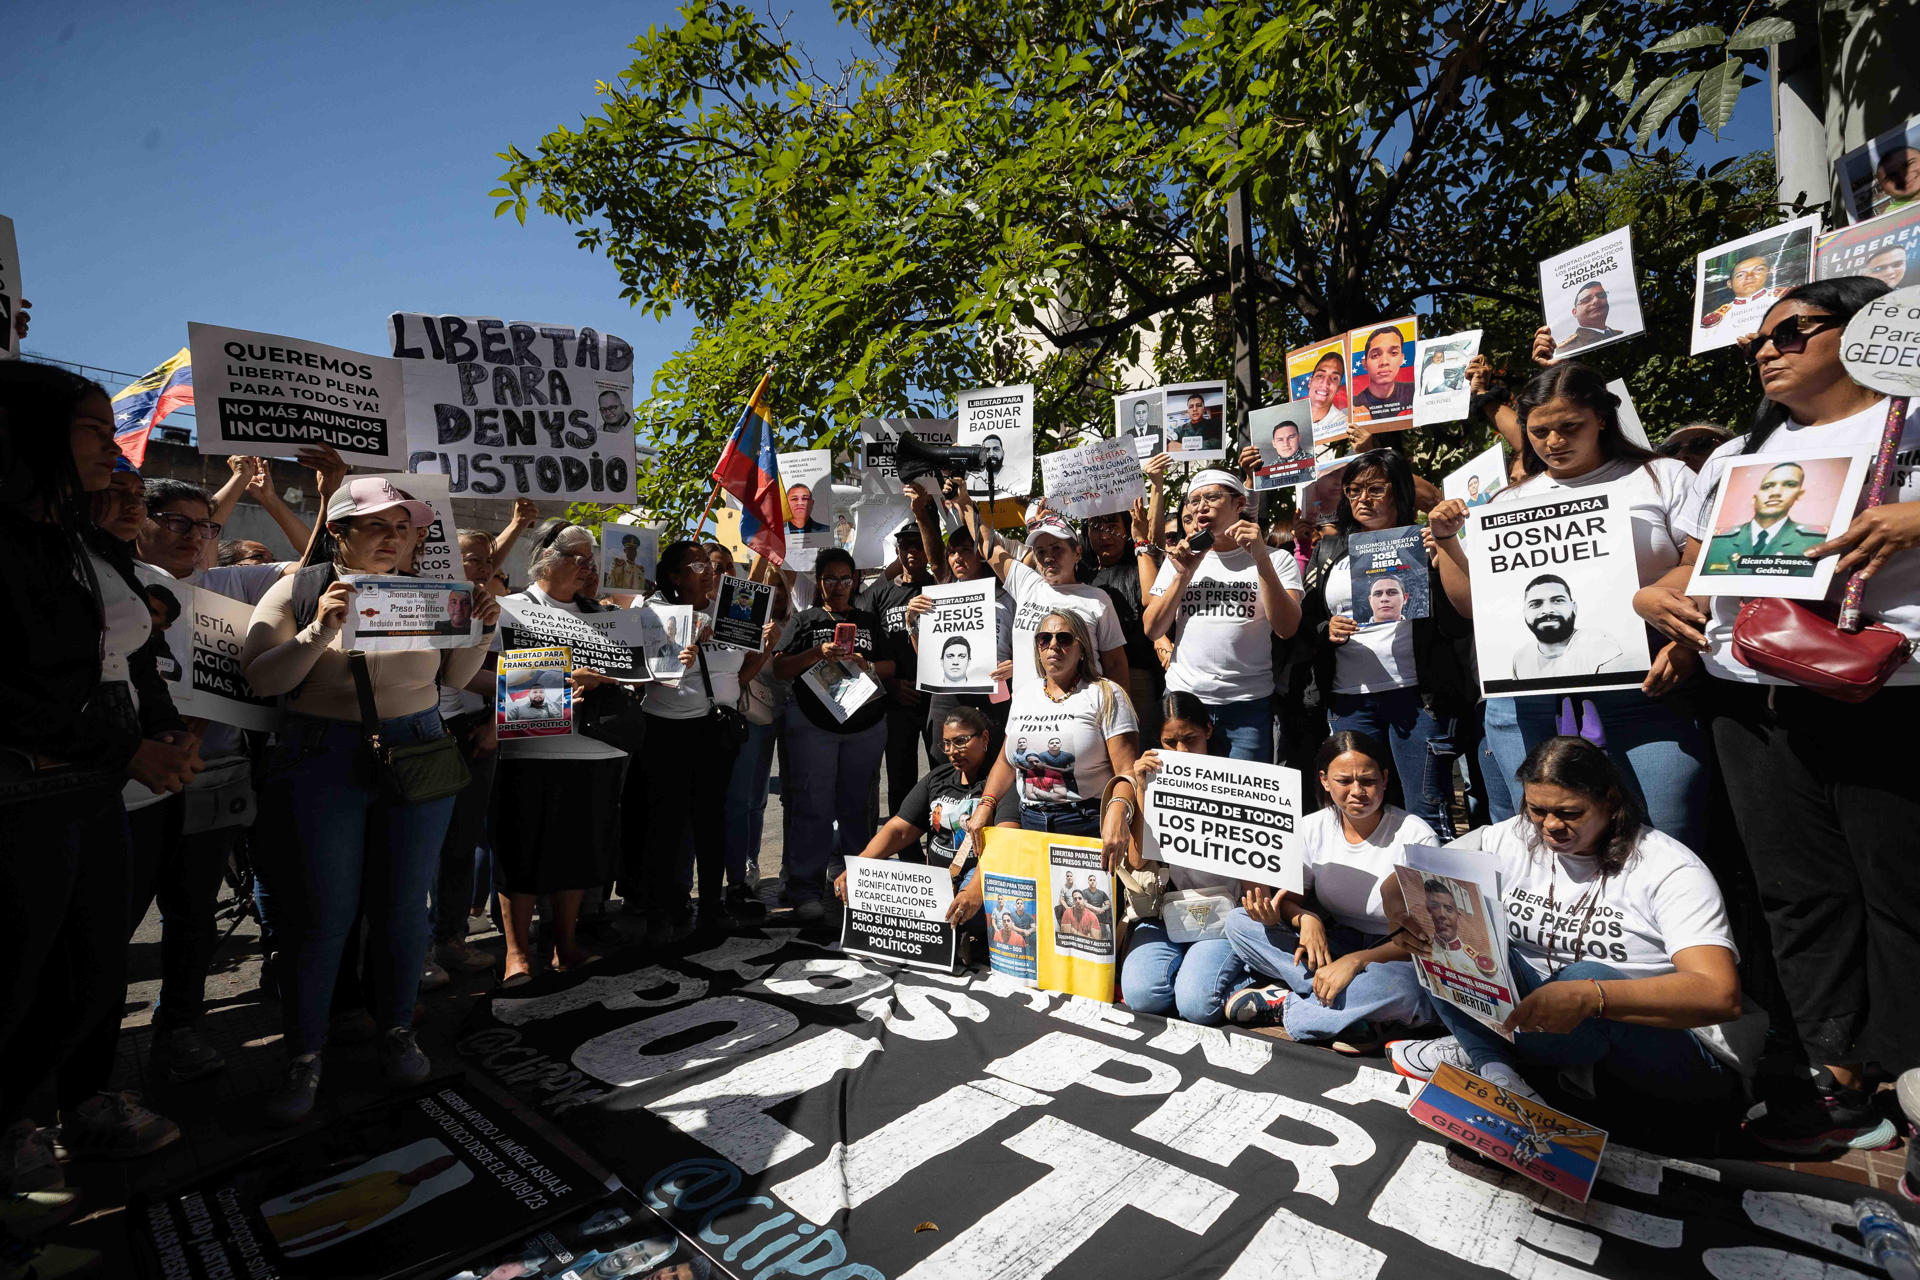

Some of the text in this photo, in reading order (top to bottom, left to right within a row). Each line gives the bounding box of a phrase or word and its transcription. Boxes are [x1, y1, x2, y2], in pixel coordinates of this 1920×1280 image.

[1554, 240, 1623, 272] LIBERTAD PARA TODOS
[1556, 270, 1567, 278] LOS
[1568, 260, 1590, 272] PRESOS
[1562, 262, 1618, 290] CARDENAS
[1564, 256, 1614, 282] JHOLMAR
[1868, 302, 1899, 318] Fe
[392, 312, 635, 373] LIBERTAD
[224, 341, 373, 380] QUEREMOS
[1845, 343, 1920, 368] GEDE
[226, 364, 380, 398] LIBERTAD PLENA
[457, 362, 572, 407] PARA
[230, 382, 380, 414] PARA TODOS YA!
[968, 396, 1022, 408] LIBERTAD PARA
[225, 402, 382, 433] NO MÁS ANUNCIOS
[969, 406, 1022, 422] JOSNAR
[433, 403, 598, 450] DENYS
[969, 416, 1022, 433] BADUEL
[229, 419, 381, 451] INCUMPLIDOS
[876, 432, 892, 441] LA
[1086, 449, 1126, 465] LIBERTAD
[1062, 468, 1082, 478] JUAN
[1082, 465, 1104, 474] PABLO
[1088, 471, 1115, 482] PRESOS
[1062, 492, 1102, 504] LIBERTAD
[1485, 498, 1604, 528] LIBERTAD PARA
[1356, 536, 1420, 550] EXIGIMOS LIBERTAD
[1488, 516, 1608, 552] JOSNAR
[1359, 542, 1415, 555] INMEDIATA PARA
[1372, 548, 1398, 561] JOSÉ
[1490, 542, 1610, 574] BADUEL
[1372, 558, 1402, 569] RIERA
[724, 576, 770, 594] LIBERTAD
[1218, 580, 1258, 590] A TODOS
[388, 591, 440, 600] Jhonatan Rangel
[932, 594, 984, 607] LIBERTAD PARA
[1204, 590, 1258, 603] PRESOS
[390, 604, 412, 613] Preso
[886, 612, 902, 624] LOS
[934, 604, 984, 622] JESÚS
[1182, 602, 1256, 618] POLÍTICOS
[195, 612, 236, 637] ISTÍA
[520, 608, 616, 630] CADA HORA QUE
[532, 618, 609, 638] PASAMOS SIN
[932, 618, 984, 634] ARMAS
[510, 622, 628, 646] RESPUESTAS ES UNA
[514, 630, 633, 656] FORMA DE VIOLENCIA
[503, 658, 568, 670] FRANKS CABAÑA!
[544, 650, 564, 658] PARA
[573, 648, 616, 662] ONTRA
[617, 654, 633, 663] LAS
[573, 656, 588, 665] DE
[590, 657, 633, 670] PRESOS
[194, 669, 237, 697] IMAS,
[498, 722, 528, 731] PRESO
[1020, 724, 1060, 732] PDVSA
[1166, 764, 1280, 792] LOS FAMILIARES
[1156, 777, 1292, 808] SEGUIMOS ESPERANDO LA
[1154, 794, 1293, 830] LIBERTAD DE TODOS
[1158, 812, 1284, 850] LOS PRESOS
[1052, 850, 1089, 860] LIBERTAD PARA
[1062, 858, 1081, 866] PRESOS
[1160, 832, 1282, 873] POLÍTICOS
[859, 868, 932, 884] NO HAY NÚMERO
[986, 878, 1034, 891] LIBERTAD PARA TODOS
[858, 878, 934, 896] SIGNIFICATIVO DE
[854, 890, 938, 909] EXCARCELACIONES
[1509, 888, 1562, 914] IBEREN
[861, 902, 926, 920] EN VENEZUELA
[852, 910, 940, 934] PERO SÍ UN NÚMERO
[1539, 912, 1623, 938] PRESOS
[852, 922, 943, 945] DOLOROSO DE PRESOS
[1508, 922, 1629, 963] OLÍTICOS
[869, 934, 922, 955] POLÍTICOS
[683, 927, 989, 1041] LOS
[1452, 990, 1492, 1016] LIBERTAD
[416, 1097, 445, 1121] PRESO
[1464, 1079, 1488, 1099] Fé
[1525, 1108, 1572, 1136] vida
[1474, 1113, 1498, 1130] de
[437, 1088, 472, 1114] LIBEREN
[463, 1110, 500, 1136] ARVEDO
[496, 1138, 538, 1168] JIMÉNEZ
[527, 1164, 573, 1198] ASUAJE
[464, 1140, 499, 1168] DESDE
[488, 1160, 507, 1174] EL
[496, 1168, 549, 1210] 29/09/23
[196, 1240, 237, 1280] JUSTICI
